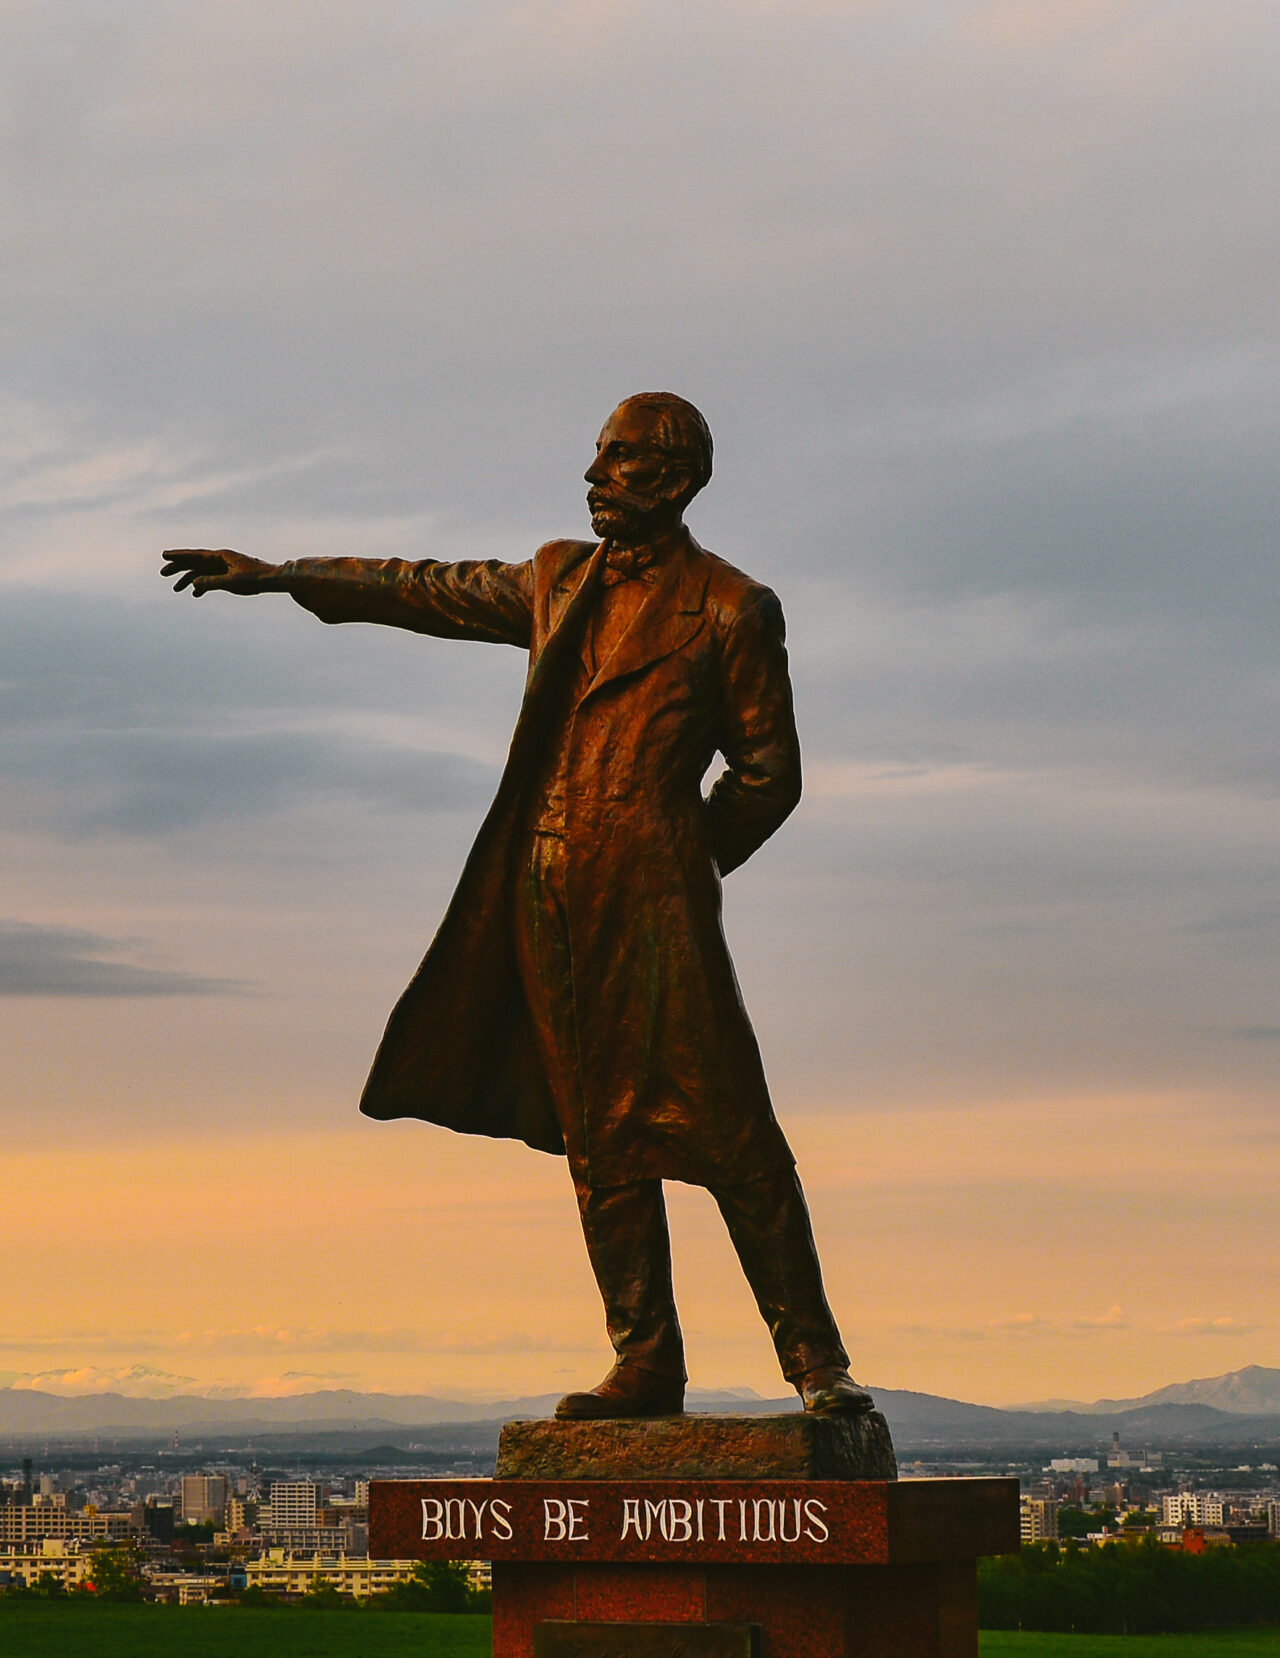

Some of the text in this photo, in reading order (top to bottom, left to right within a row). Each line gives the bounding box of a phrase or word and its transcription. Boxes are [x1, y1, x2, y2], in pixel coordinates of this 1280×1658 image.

[420, 1498, 829, 1543] BOYS BE AMBITIOUS
